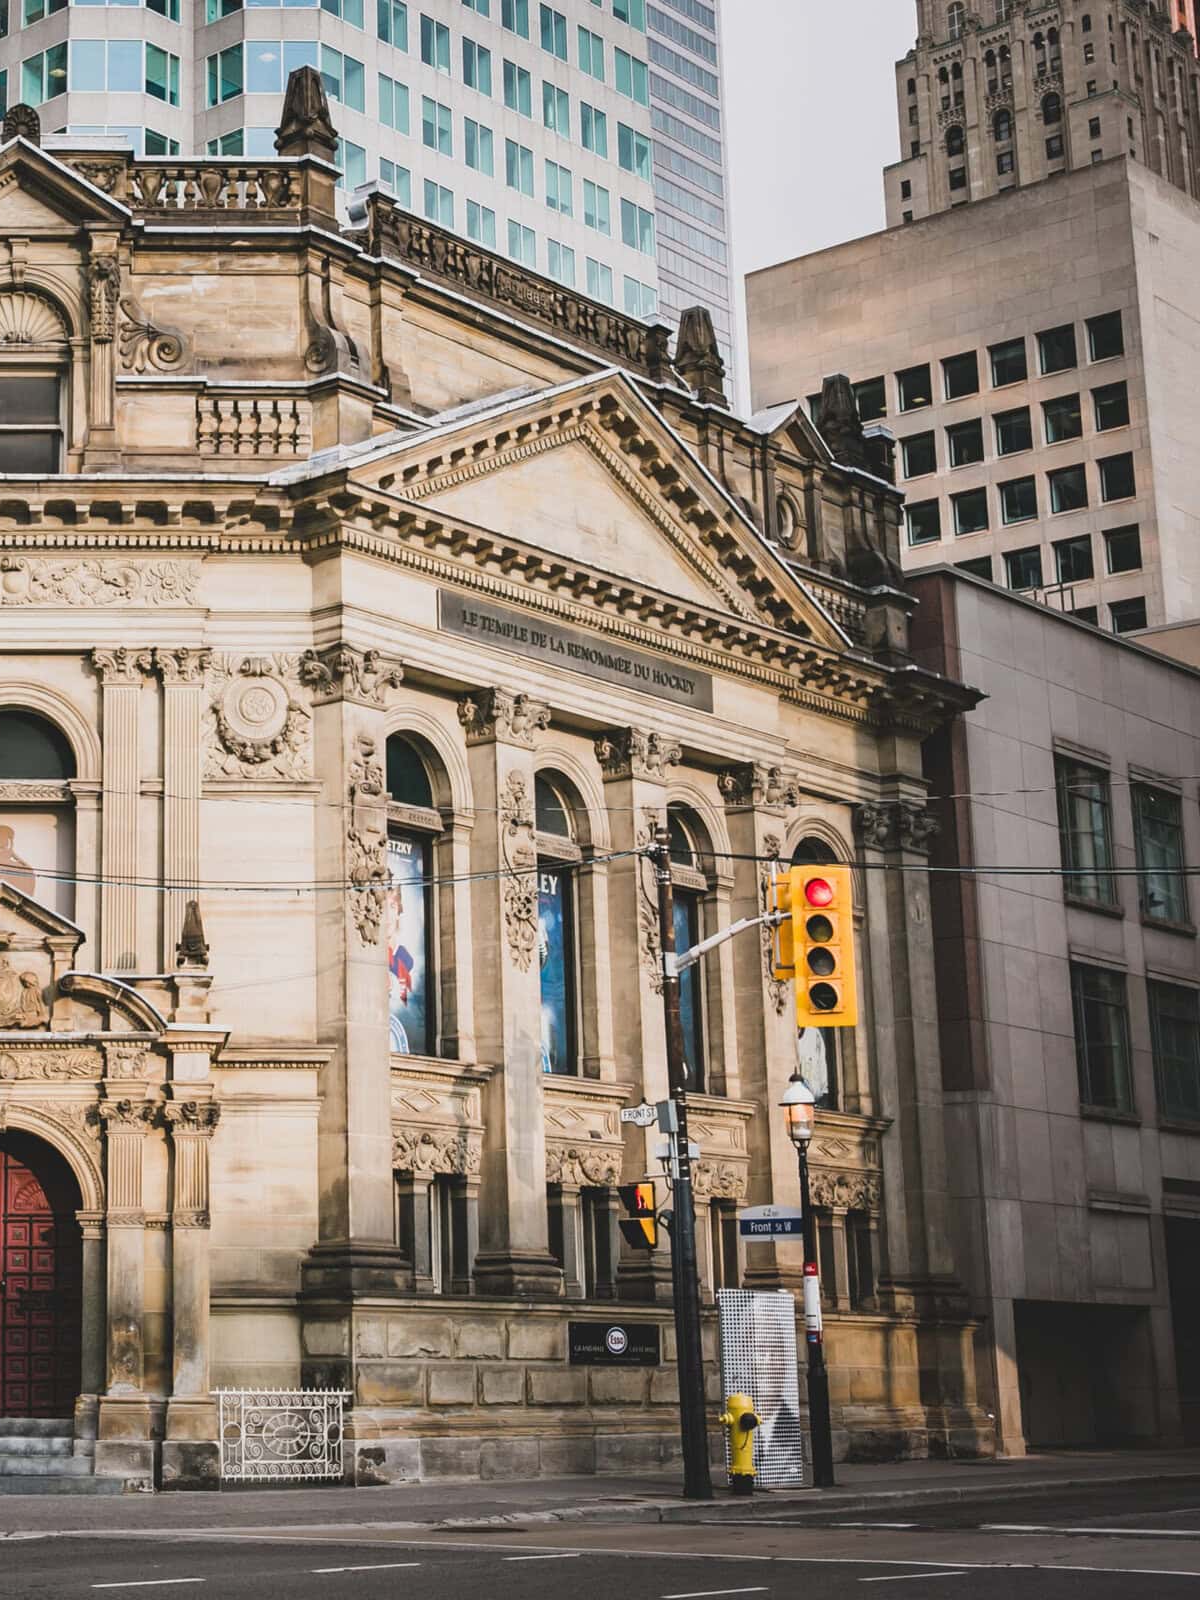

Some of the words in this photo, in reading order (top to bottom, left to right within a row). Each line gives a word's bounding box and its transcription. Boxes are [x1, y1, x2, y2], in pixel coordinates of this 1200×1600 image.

[461, 609, 478, 628] LE
[479, 615, 529, 642] TEMPLE
[531, 630, 547, 649] DE
[549, 636, 566, 655] LA
[632, 663, 650, 682] DU
[651, 669, 696, 696] HOCKEY
[386, 839, 412, 855] ETZKY
[536, 873, 558, 895] EY
[623, 1109, 645, 1120] FRONT
[750, 1222, 772, 1233] Front
[784, 1221, 792, 1232] W
